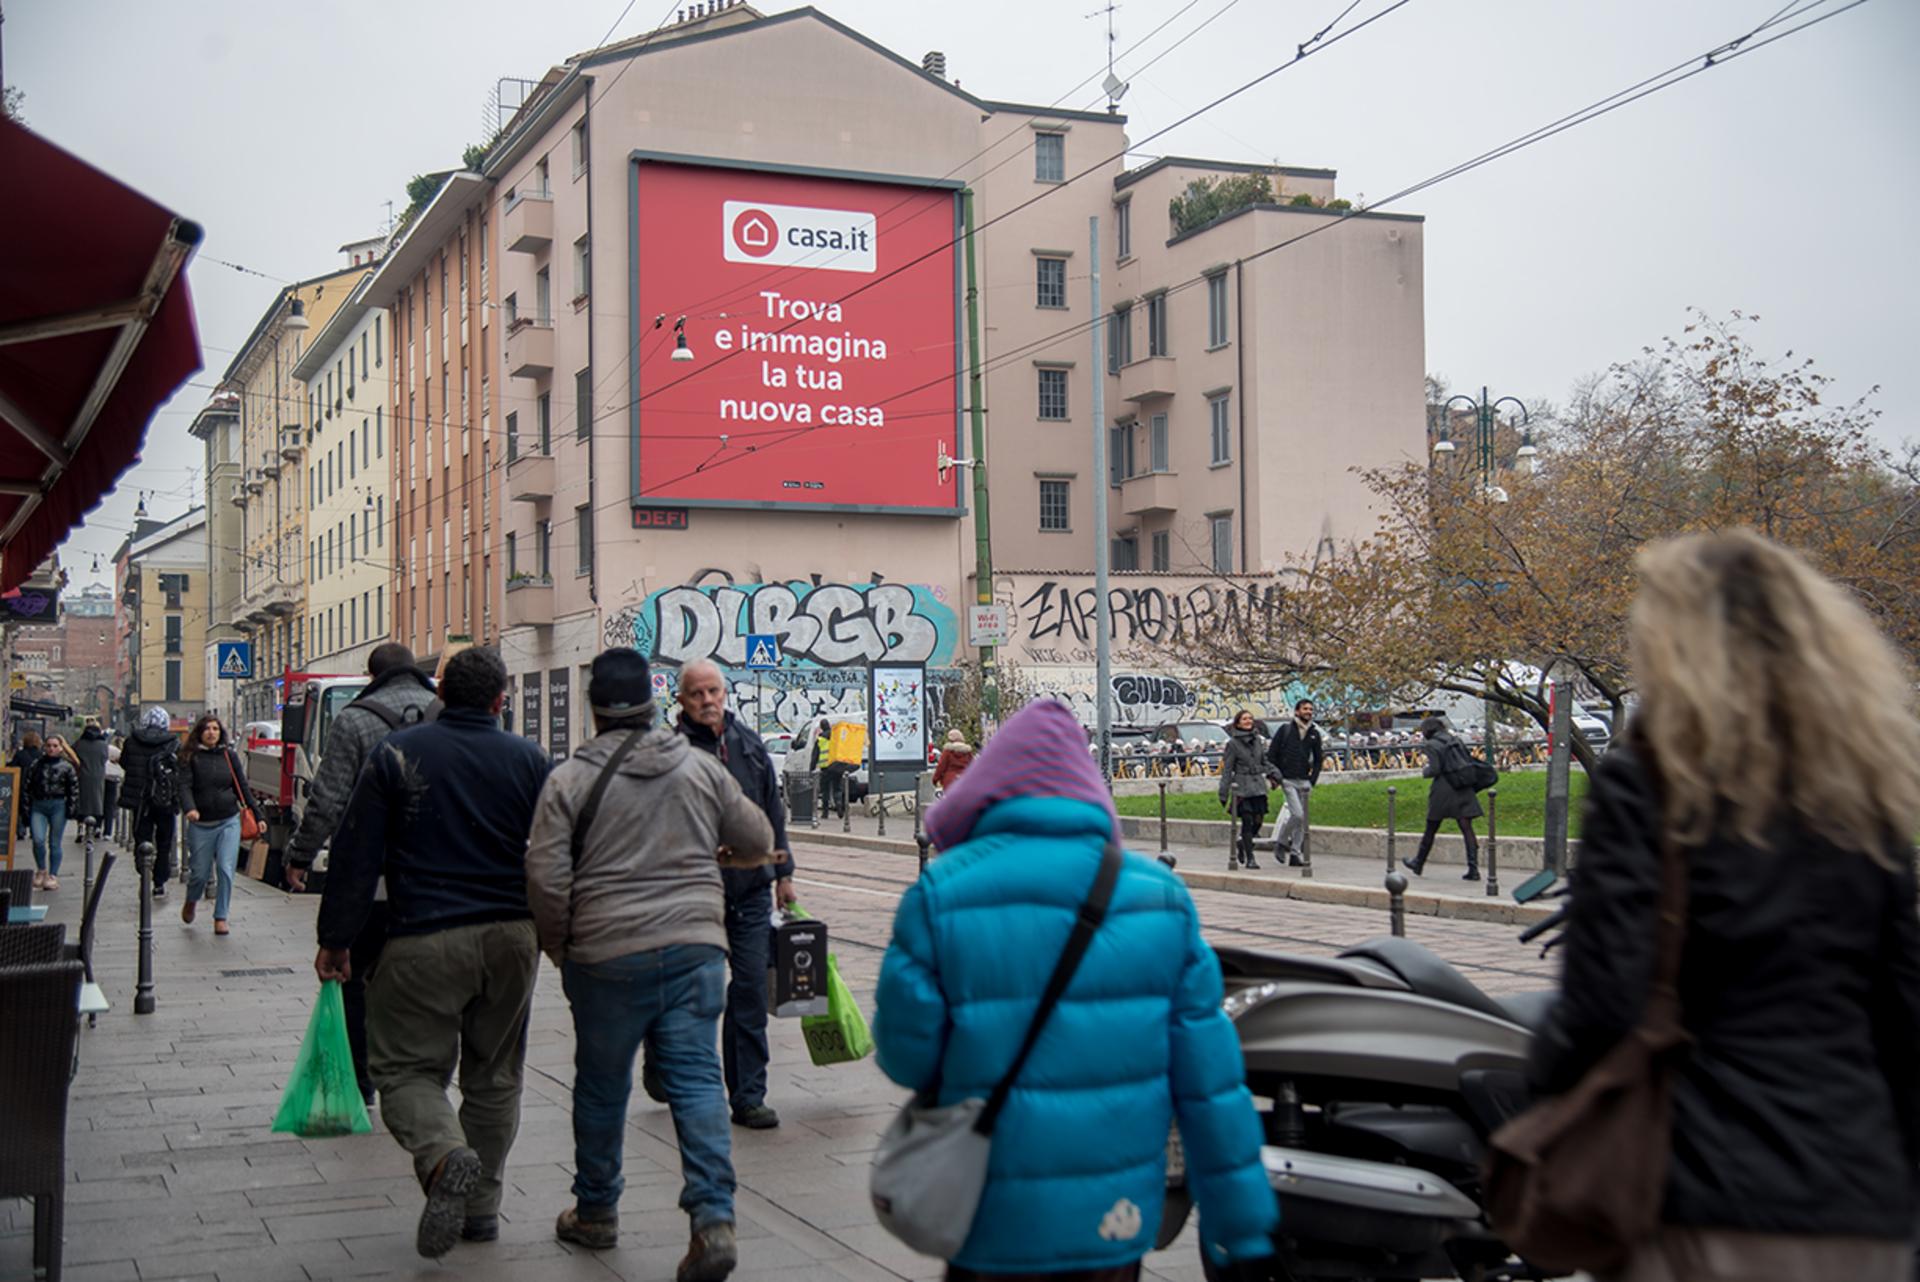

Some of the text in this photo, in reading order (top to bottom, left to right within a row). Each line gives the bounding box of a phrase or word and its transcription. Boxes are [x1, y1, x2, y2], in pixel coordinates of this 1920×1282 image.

[787, 226, 868, 252] casa.it
[759, 291, 842, 323] Trova
[714, 325, 887, 363] e immagina
[762, 361, 843, 391] la tua
[720, 399, 884, 427] nuova casa
[634, 511, 687, 526] DEFI
